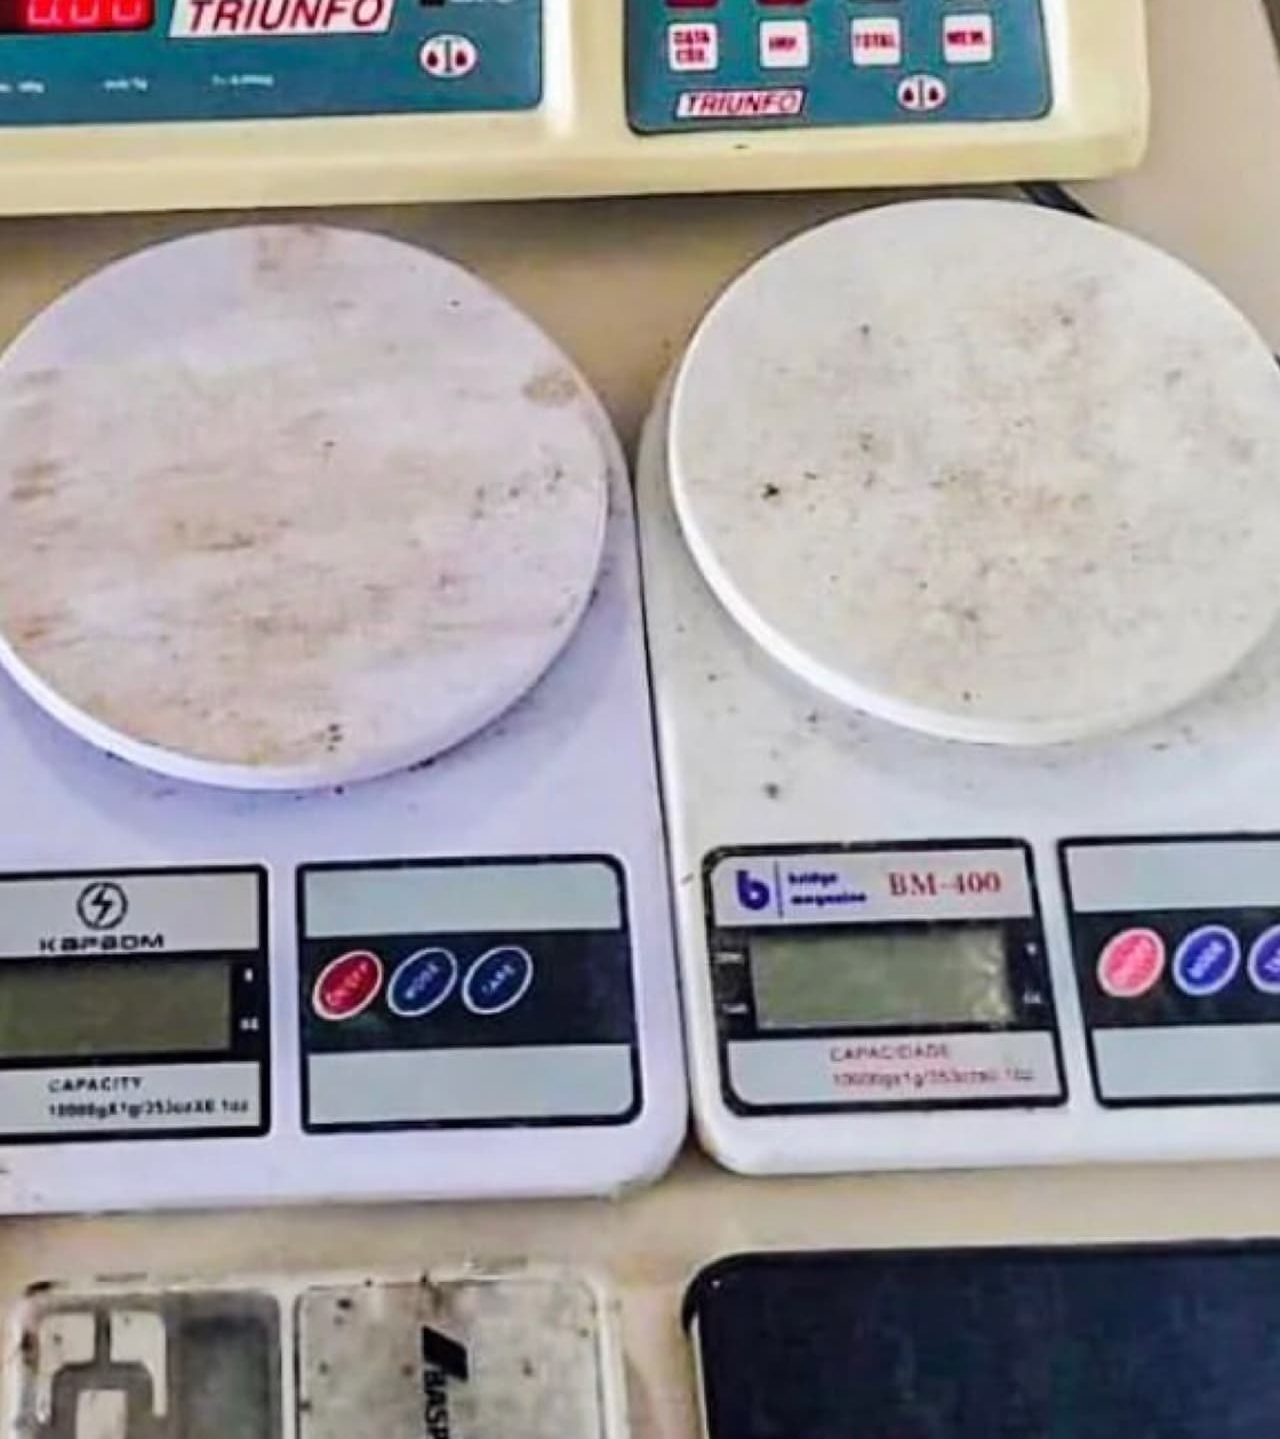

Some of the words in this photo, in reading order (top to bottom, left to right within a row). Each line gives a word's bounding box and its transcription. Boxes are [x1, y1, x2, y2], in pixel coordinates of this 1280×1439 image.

[685, 92, 798, 114] TRIUNFO
[889, 870, 1002, 896] BM-400
[47, 1076, 143, 1093] CAPACITY
